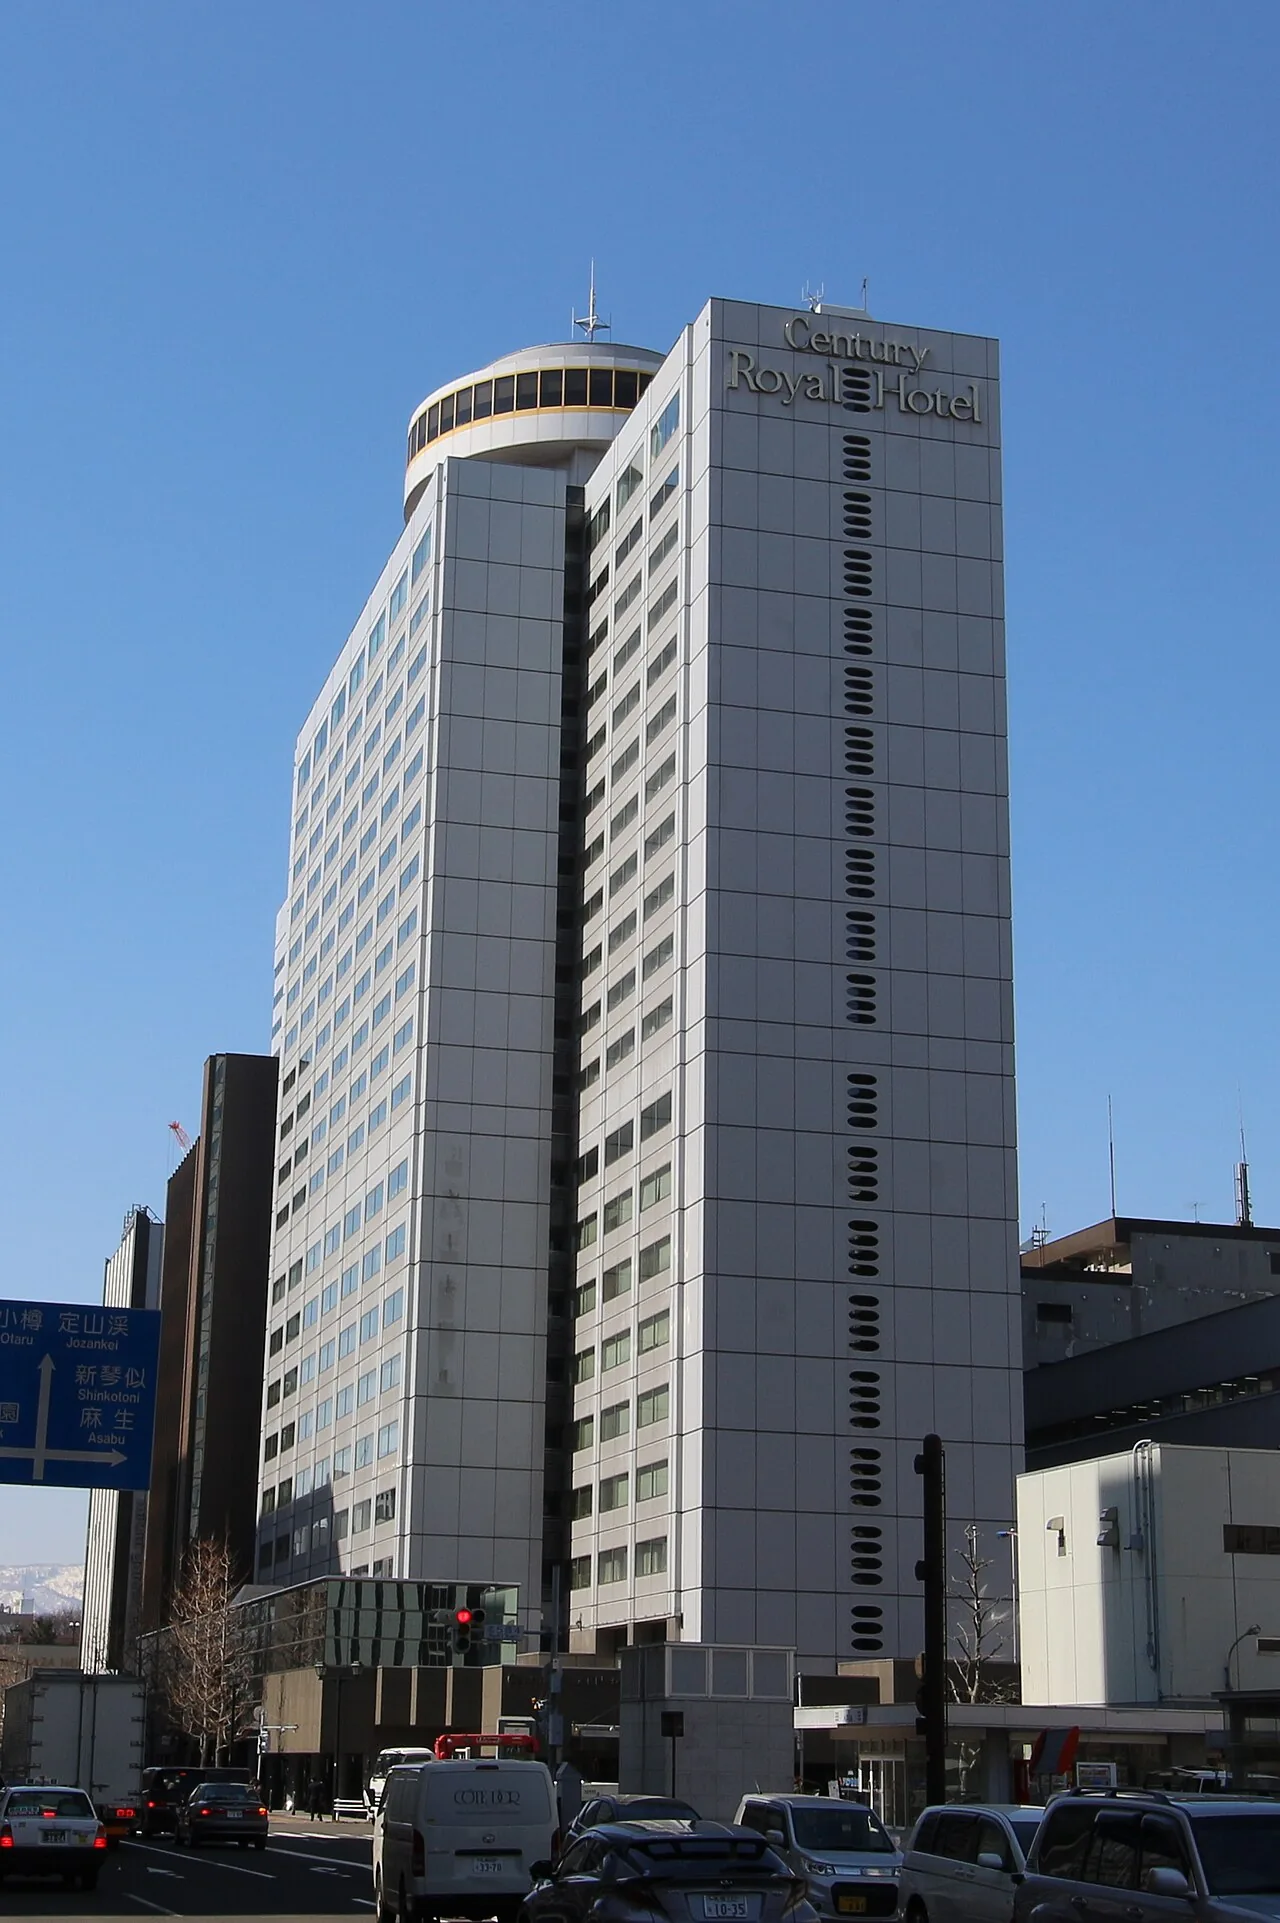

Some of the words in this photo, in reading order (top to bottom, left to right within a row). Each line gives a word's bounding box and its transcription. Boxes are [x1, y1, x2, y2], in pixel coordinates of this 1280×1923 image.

[784, 317, 930, 375] Century
[728, 350, 842, 406] Royal
[873, 370, 982, 424] Hotel
[58, 1312, 129, 1337] 定山渓
[1, 1332, 34, 1345] Otaru
[66, 1337, 119, 1351] Jozankei
[75, 1364, 146, 1389] 新琴似
[78, 1389, 140, 1404] Shinkotoni
[80, 1407, 135, 1431] 麻生
[88, 1431, 125, 1445] Asabu
[715, 1903, 745, 1916] 10-35
